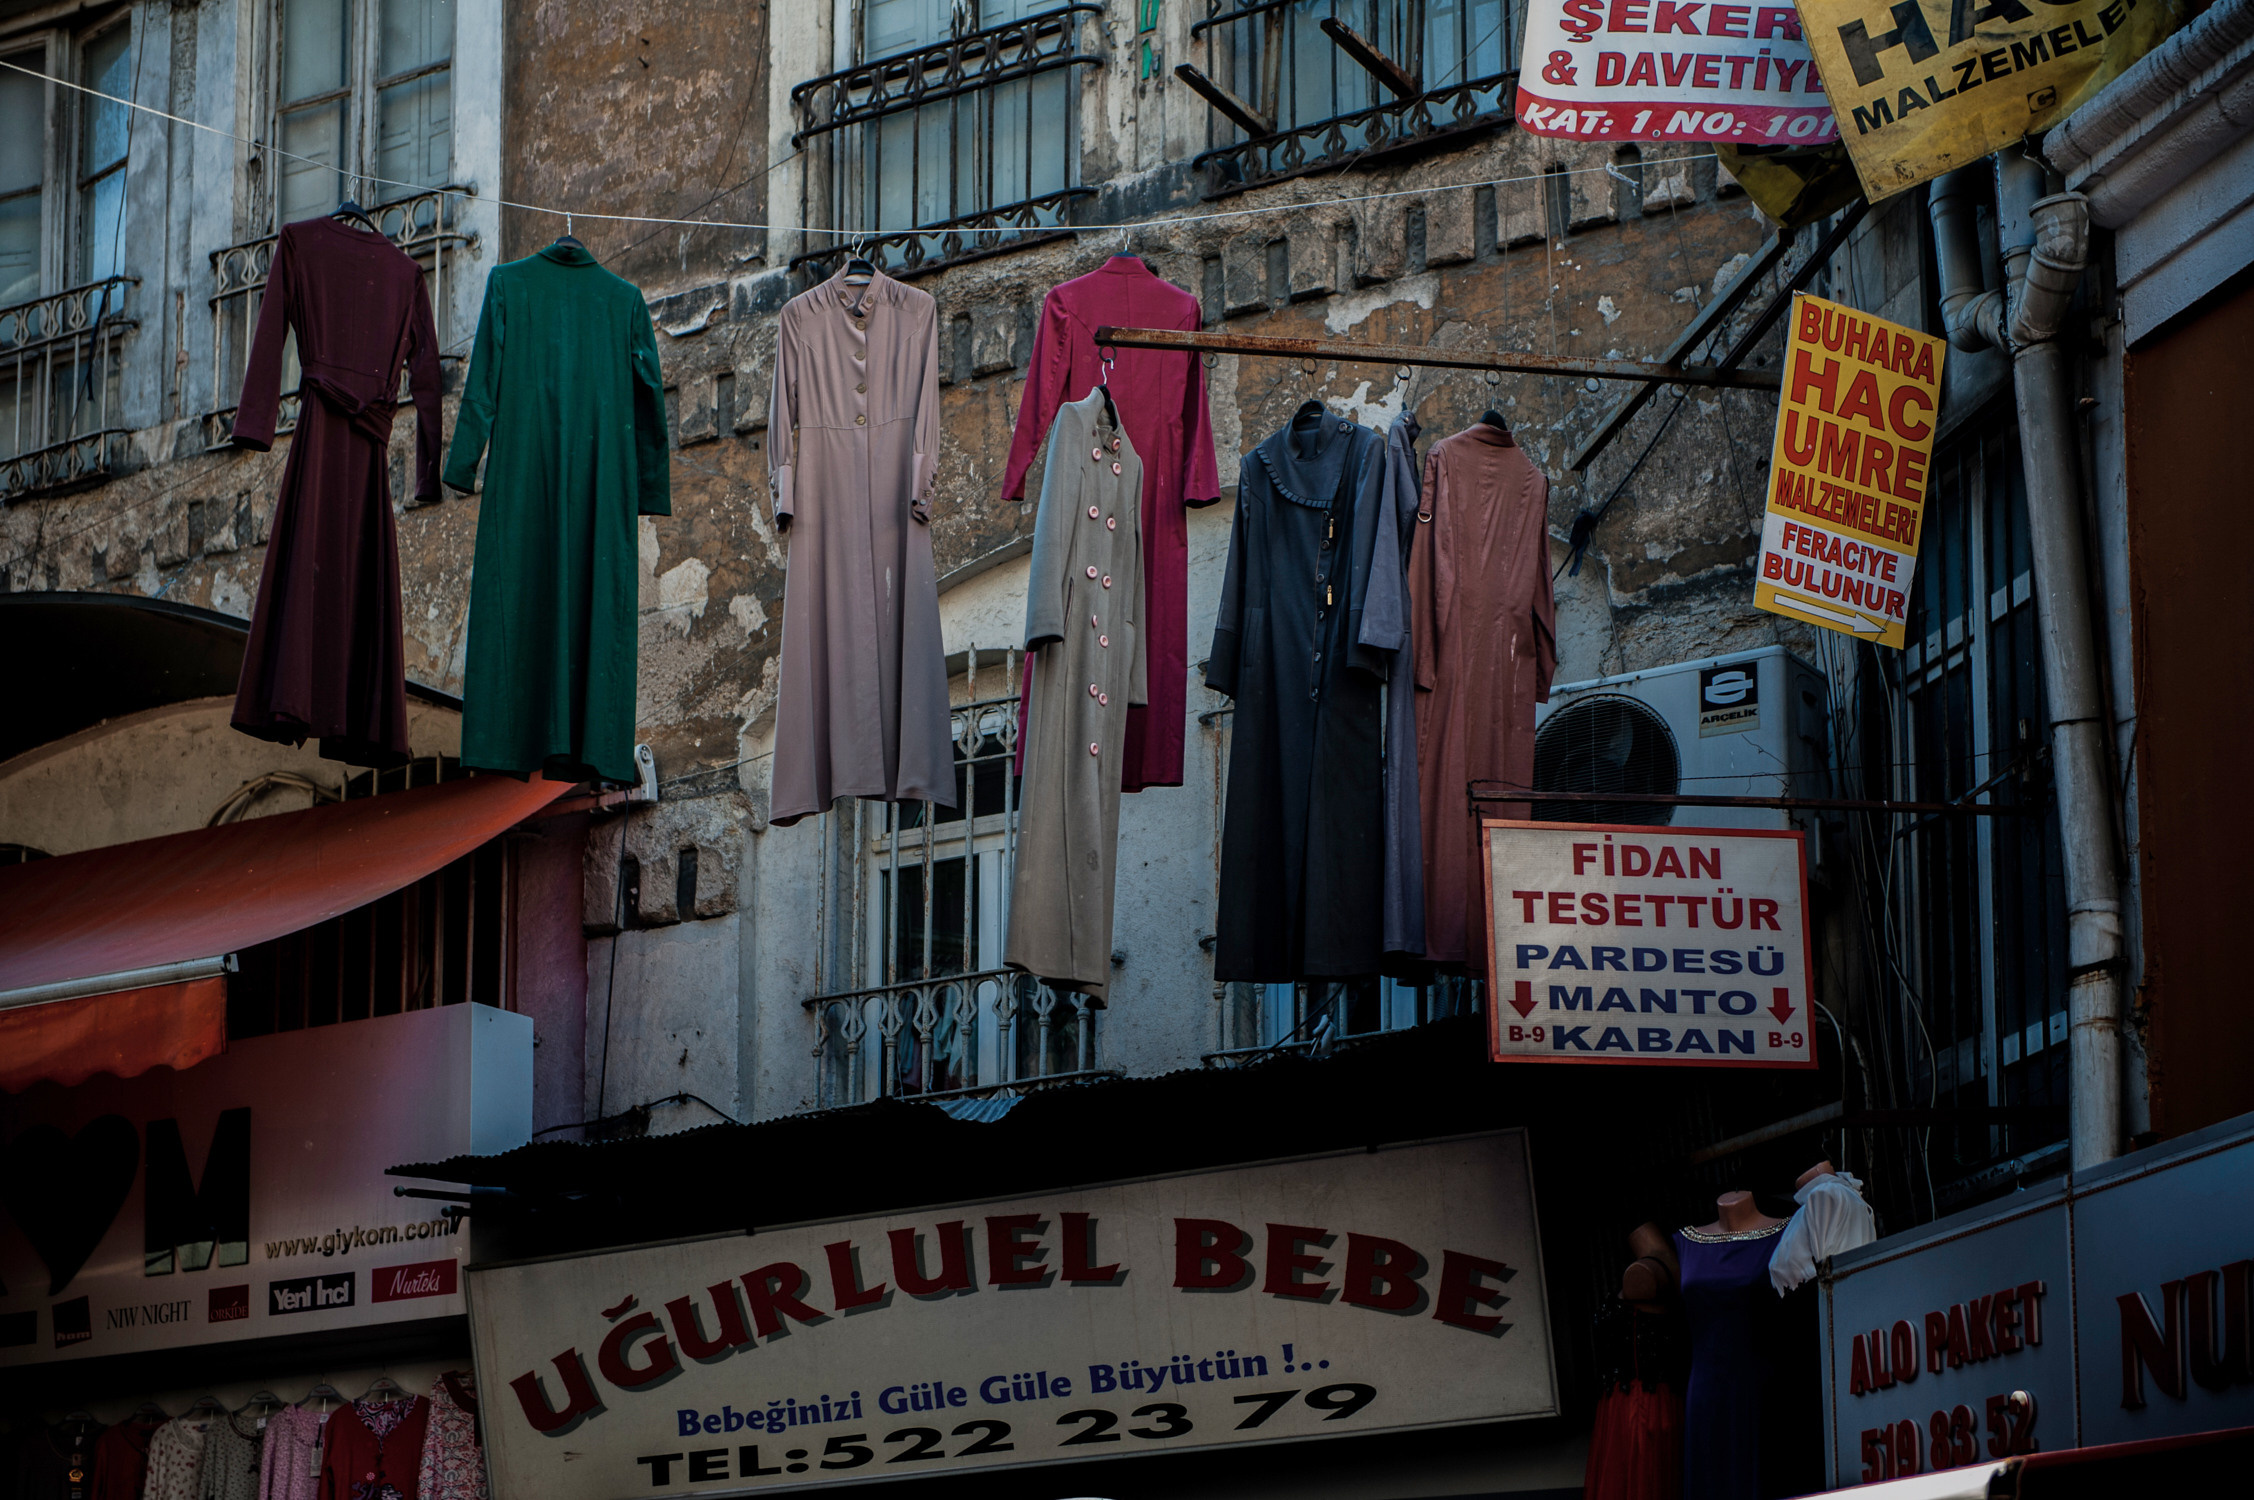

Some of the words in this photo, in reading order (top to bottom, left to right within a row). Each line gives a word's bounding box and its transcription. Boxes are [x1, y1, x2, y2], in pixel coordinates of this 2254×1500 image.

[1559, 0, 1803, 43] ŞEKER
[1837, 0, 2083, 87] HA
[1541, 50, 1578, 87] &
[1851, 0, 2137, 136] MALZEMELE
[1523, 101, 1614, 135] KAT:
[1664, 110, 1747, 136] NO:
[1798, 301, 1935, 386] BUHARA
[1790, 348, 1934, 442] HAC
[1783, 409, 1927, 504] UMRE
[1774, 467, 1918, 547] MALZEMELERİ
[1781, 521, 1898, 583] FERACİYE
[1762, 552, 1905, 619] BULUNUR
[1701, 708, 1758, 724] ARÇELİK
[1572, 834, 1722, 880] FİDAN
[1512, 887, 1782, 931] TESETTÜR
[1515, 944, 1785, 977] PARDESÜ
[1548, 985, 1758, 1016] MANTO
[1508, 1025, 1546, 1043] B-9
[1552, 1025, 1756, 1055] KABAN
[1768, 1031, 1804, 1049] B-9
[264, 1218, 450, 1258] www.giykom.com
[389, 1269, 441, 1296] Nurteks
[106, 1306, 139, 1330] NIW
[142, 1300, 191, 1326] NIGHT
[509, 1212, 1124, 1435] UĞURLUEL
[1172, 1217, 1514, 1335] BEBE
[1850, 1319, 1917, 1395] ALO
[1925, 1280, 2046, 1374] PAKET
[677, 1391, 863, 1436] Bebeğinizi
[878, 1381, 967, 1414] Güle
[979, 1371, 1072, 1405] Güle
[1088, 1350, 1268, 1394] Büyütün
[1056, 1402, 1194, 1447] 23
[1233, 1382, 1377, 1430] 79
[1861, 1418, 1921, 1484] 519
[1930, 1404, 1977, 1470] 83
[1986, 1389, 2037, 1459] 52
